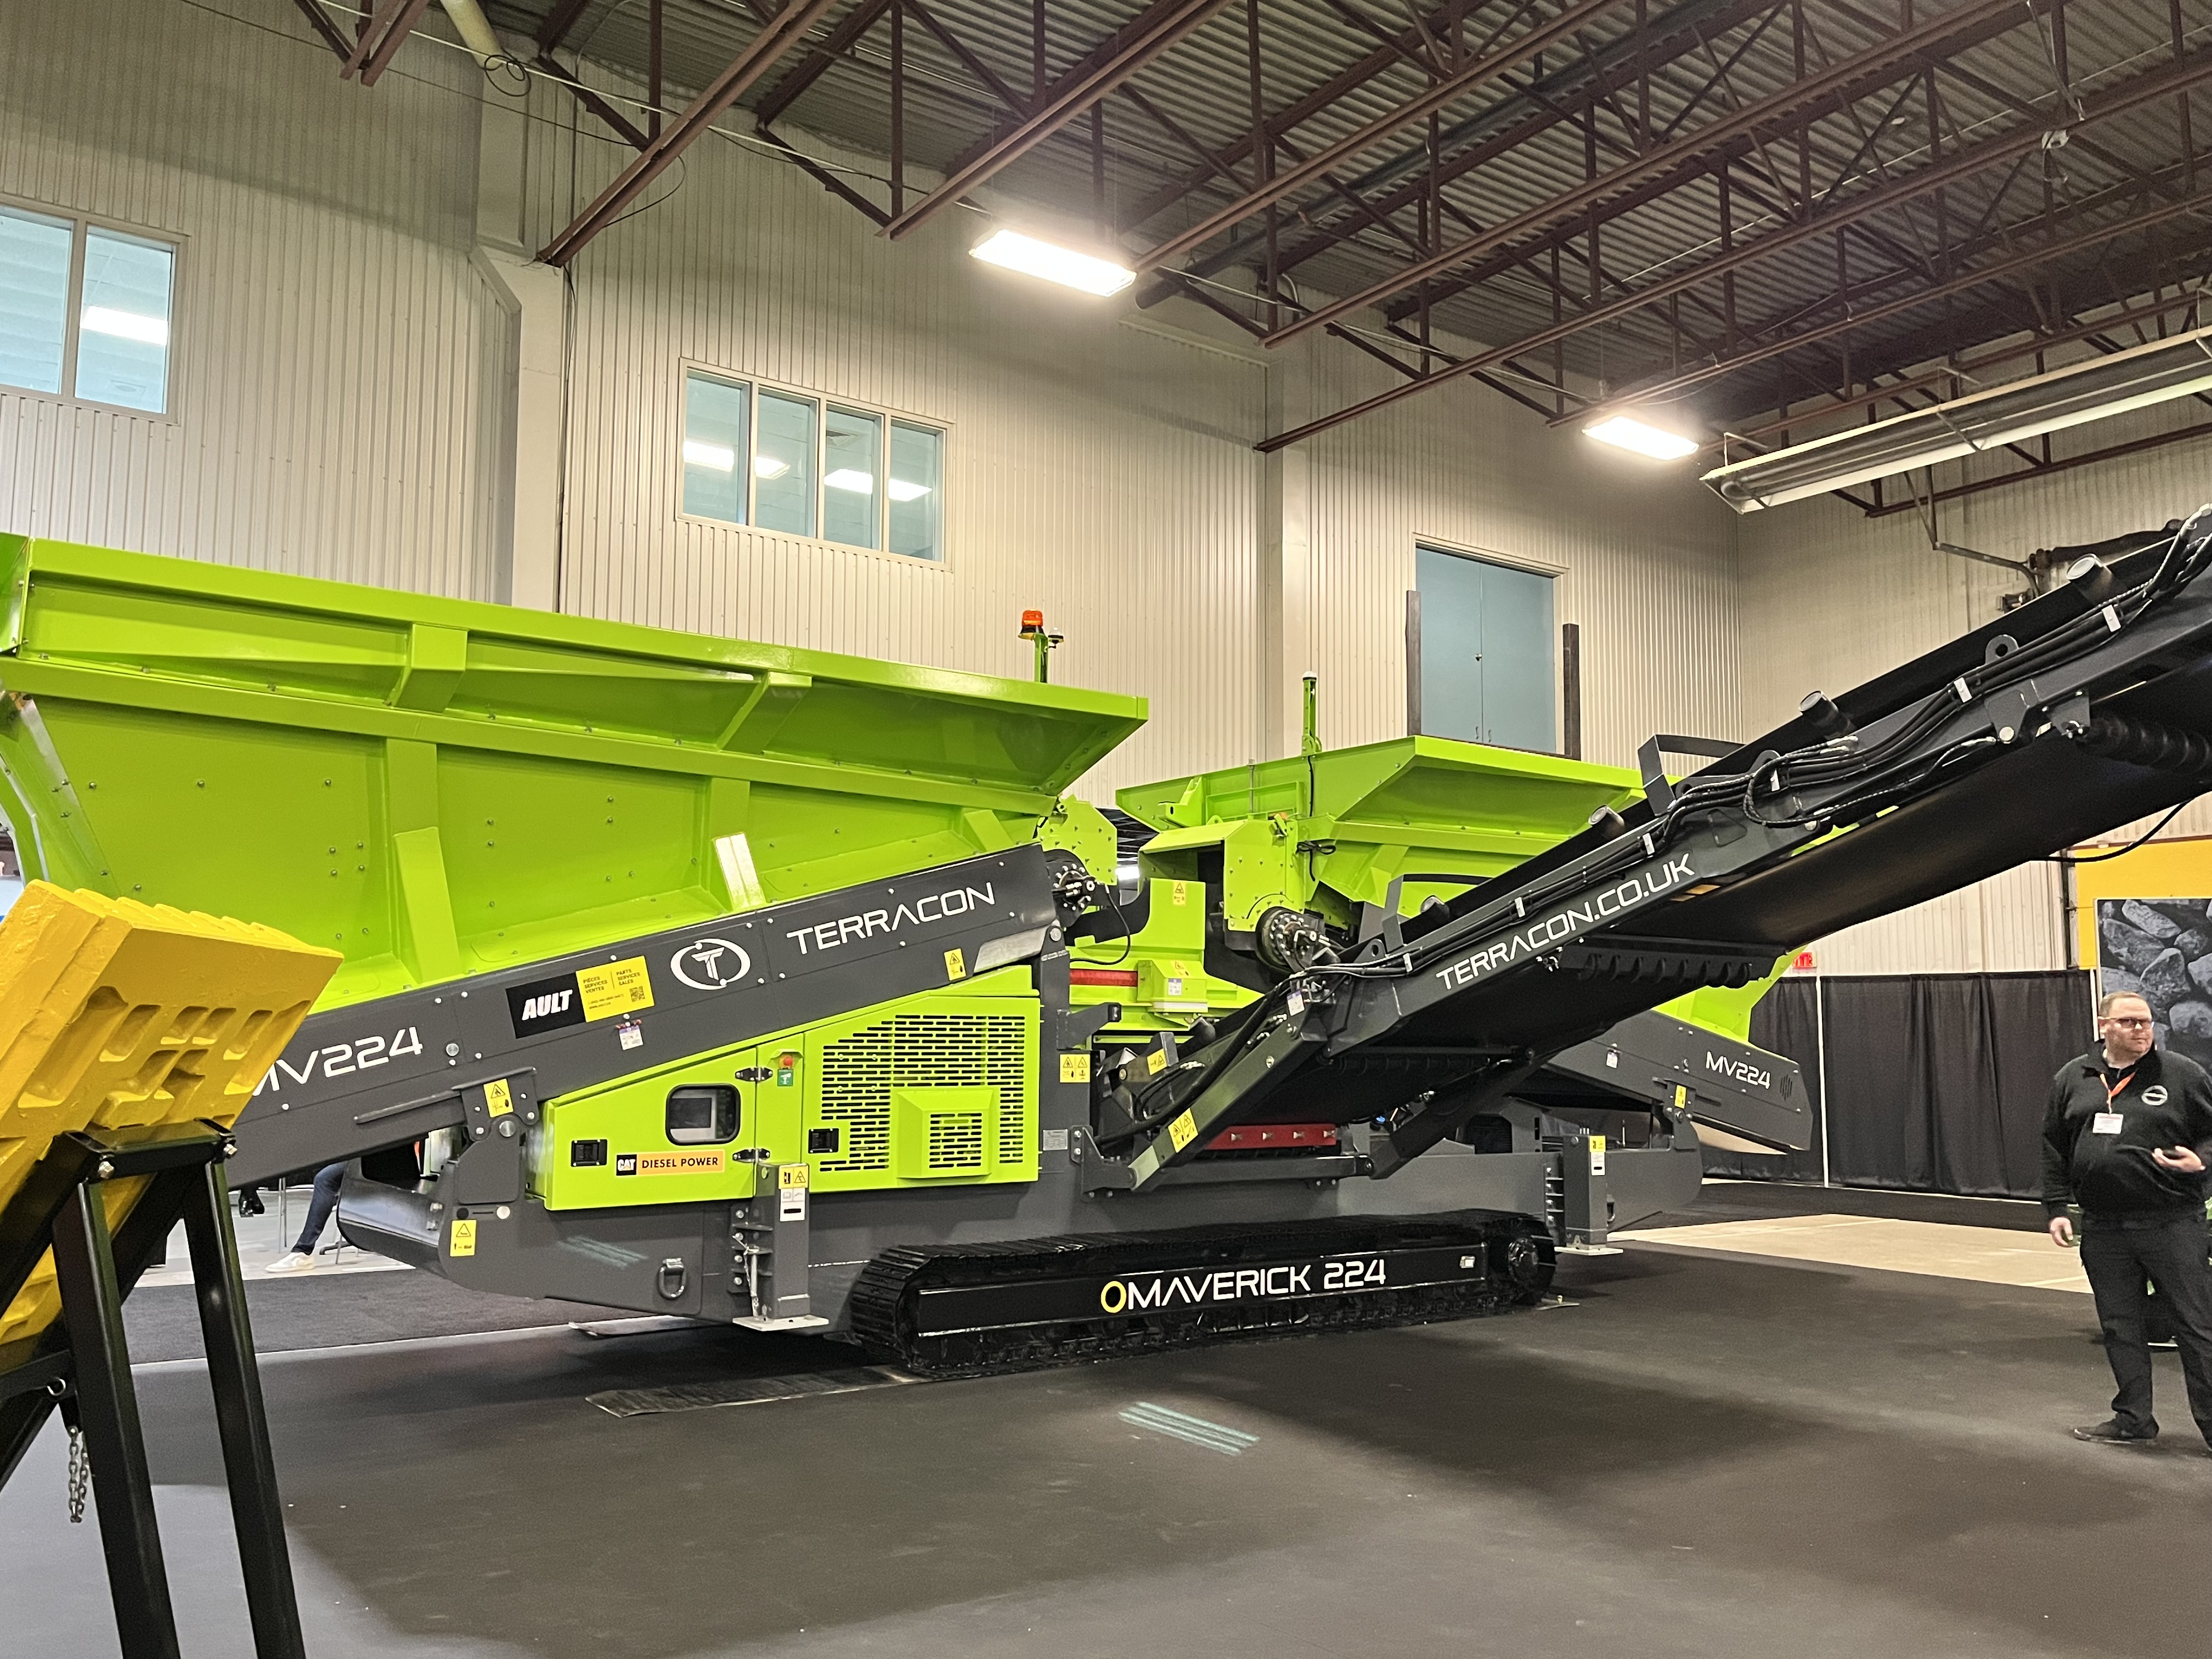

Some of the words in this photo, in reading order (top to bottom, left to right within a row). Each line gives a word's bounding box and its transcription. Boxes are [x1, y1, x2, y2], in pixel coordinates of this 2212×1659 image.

[786, 882, 995, 955] TERRACON
[1436, 853, 1695, 990] TERRACON.CO.UK
[584, 980, 607, 989] SERVICES
[618, 972, 641, 981] SERVICES
[522, 989, 573, 1020] AULT
[1706, 1051, 1770, 1090] MV224
[617, 1159, 636, 1171] CAT
[642, 1159, 677, 1169] DIESEL
[681, 1157, 718, 1167] POWER
[1324, 1259, 1386, 1289] 224
